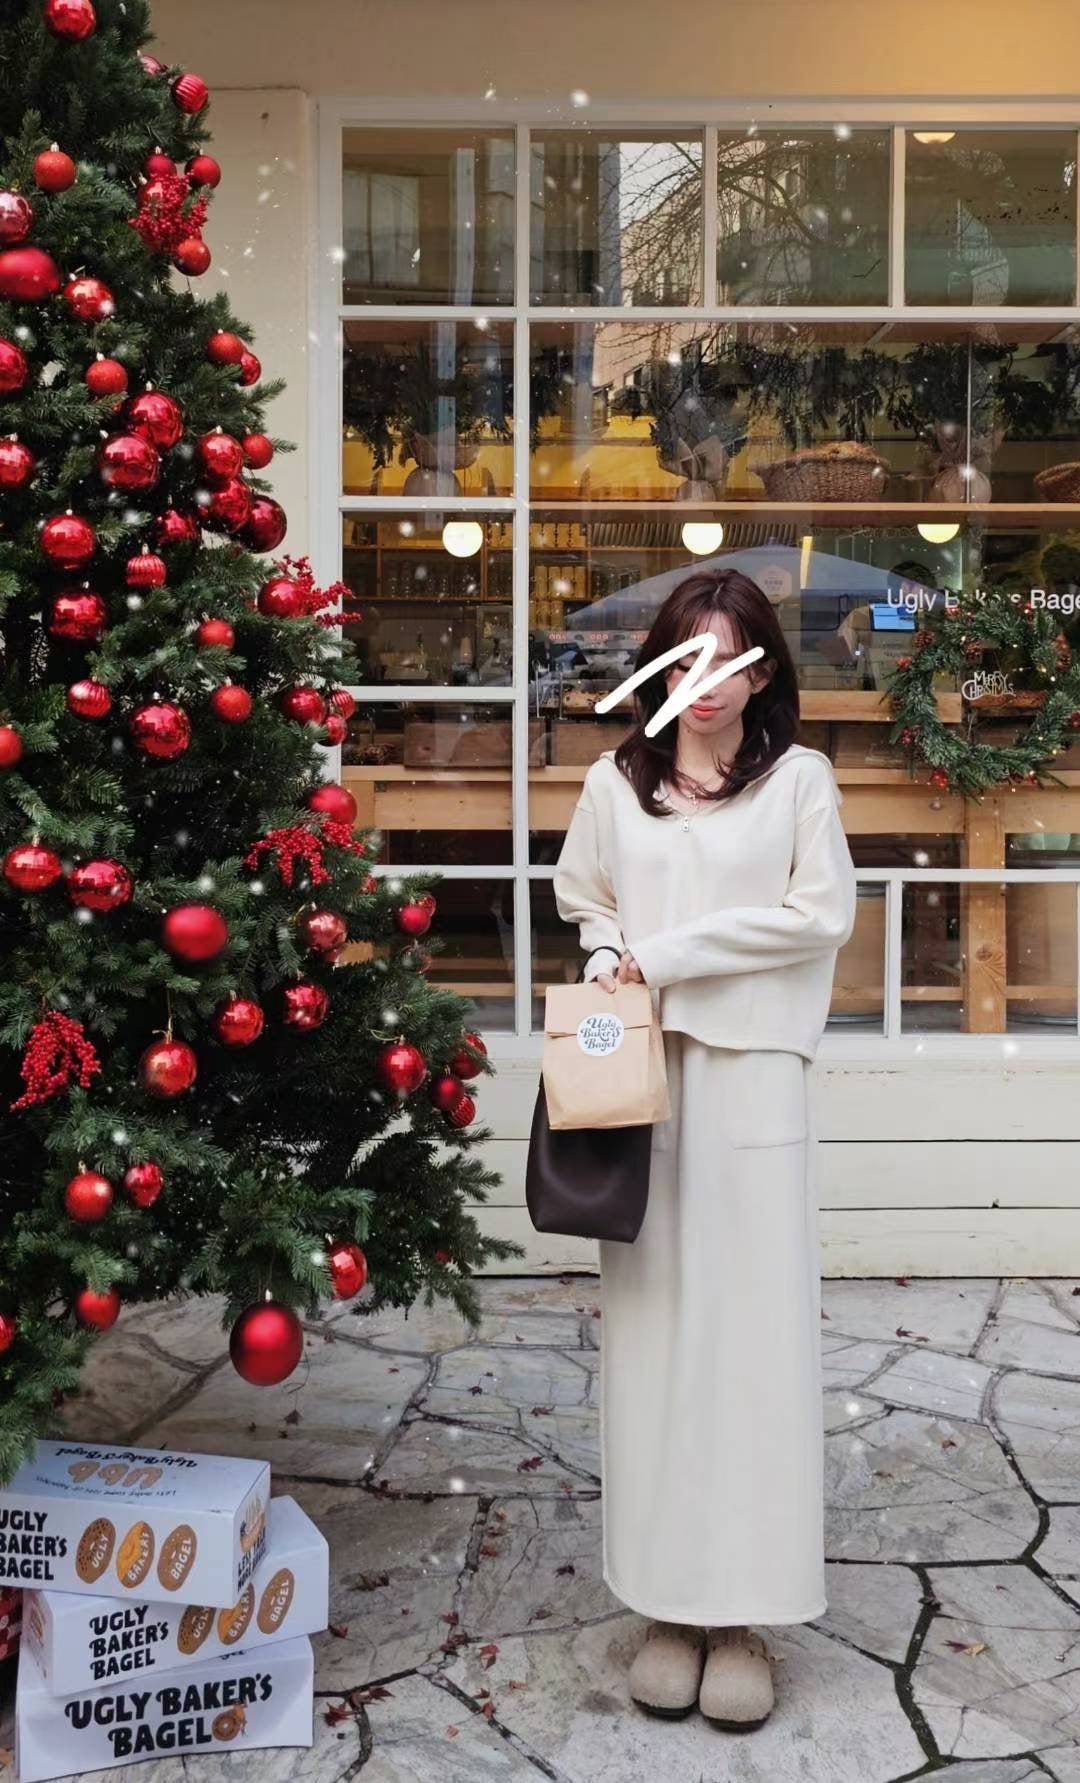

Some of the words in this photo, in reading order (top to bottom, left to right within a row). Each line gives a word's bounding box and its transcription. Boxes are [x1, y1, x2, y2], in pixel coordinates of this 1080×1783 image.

[887, 588, 937, 613] Ugly
[586, 1017, 617, 1031] Ugly
[584, 1038, 616, 1052] Bagel
[91, 1534, 109, 1569] UGLY
[170, 1537, 192, 1580] BAGEL
[270, 1579, 289, 1622] BAGEL
[89, 1605, 149, 1635] UGLY
[89, 1621, 169, 1658] BAKER'S
[90, 1648, 156, 1680] BAGEL
[64, 1692, 152, 1729] UGLY
[156, 1673, 273, 1716] BAKER'S
[107, 1717, 212, 1758] BAGEL
